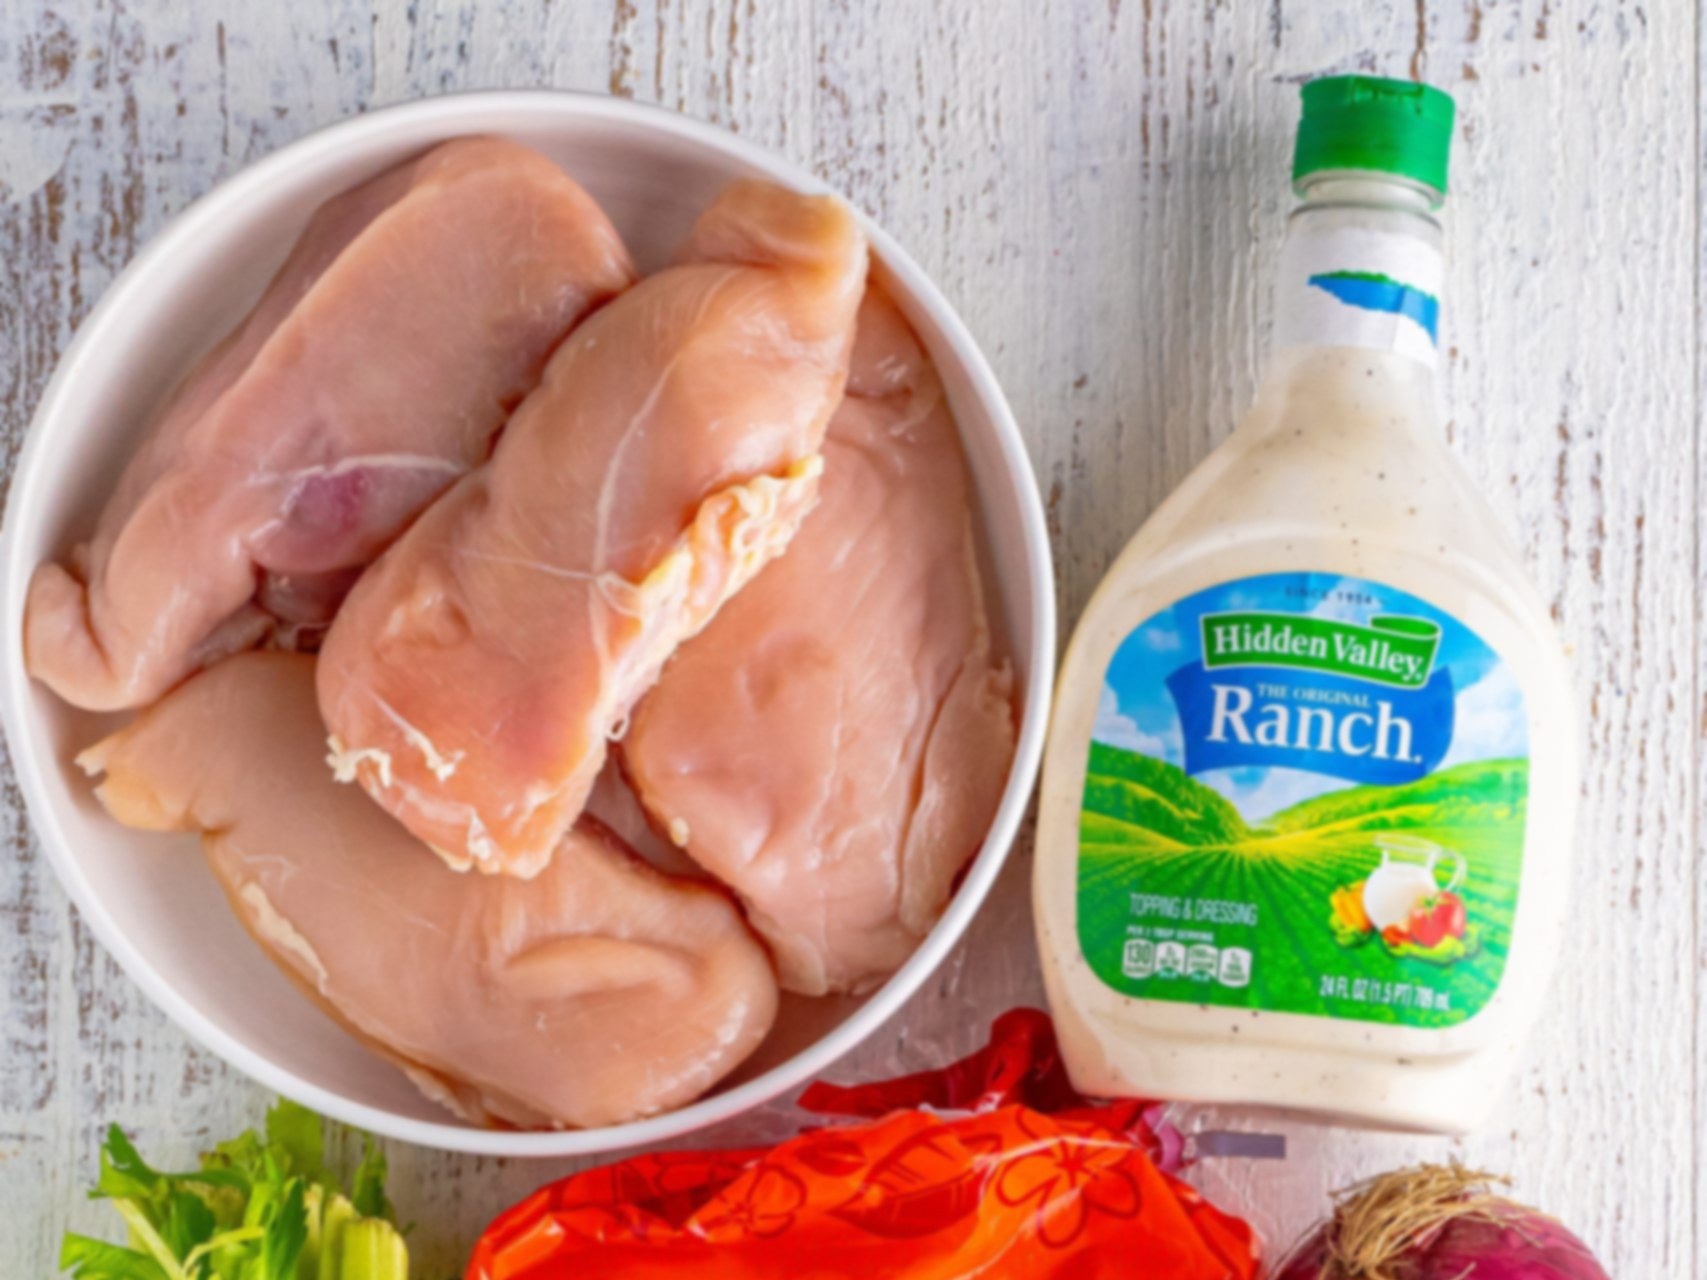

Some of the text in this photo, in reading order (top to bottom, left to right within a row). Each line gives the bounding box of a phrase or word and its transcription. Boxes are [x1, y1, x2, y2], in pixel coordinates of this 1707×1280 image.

[1212, 622, 1328, 659] Hidden
[1257, 683, 1371, 709] THE ORIGINAL
[1129, 892, 1181, 919] TOPPING
[1195, 898, 1258, 927] DRESSING
